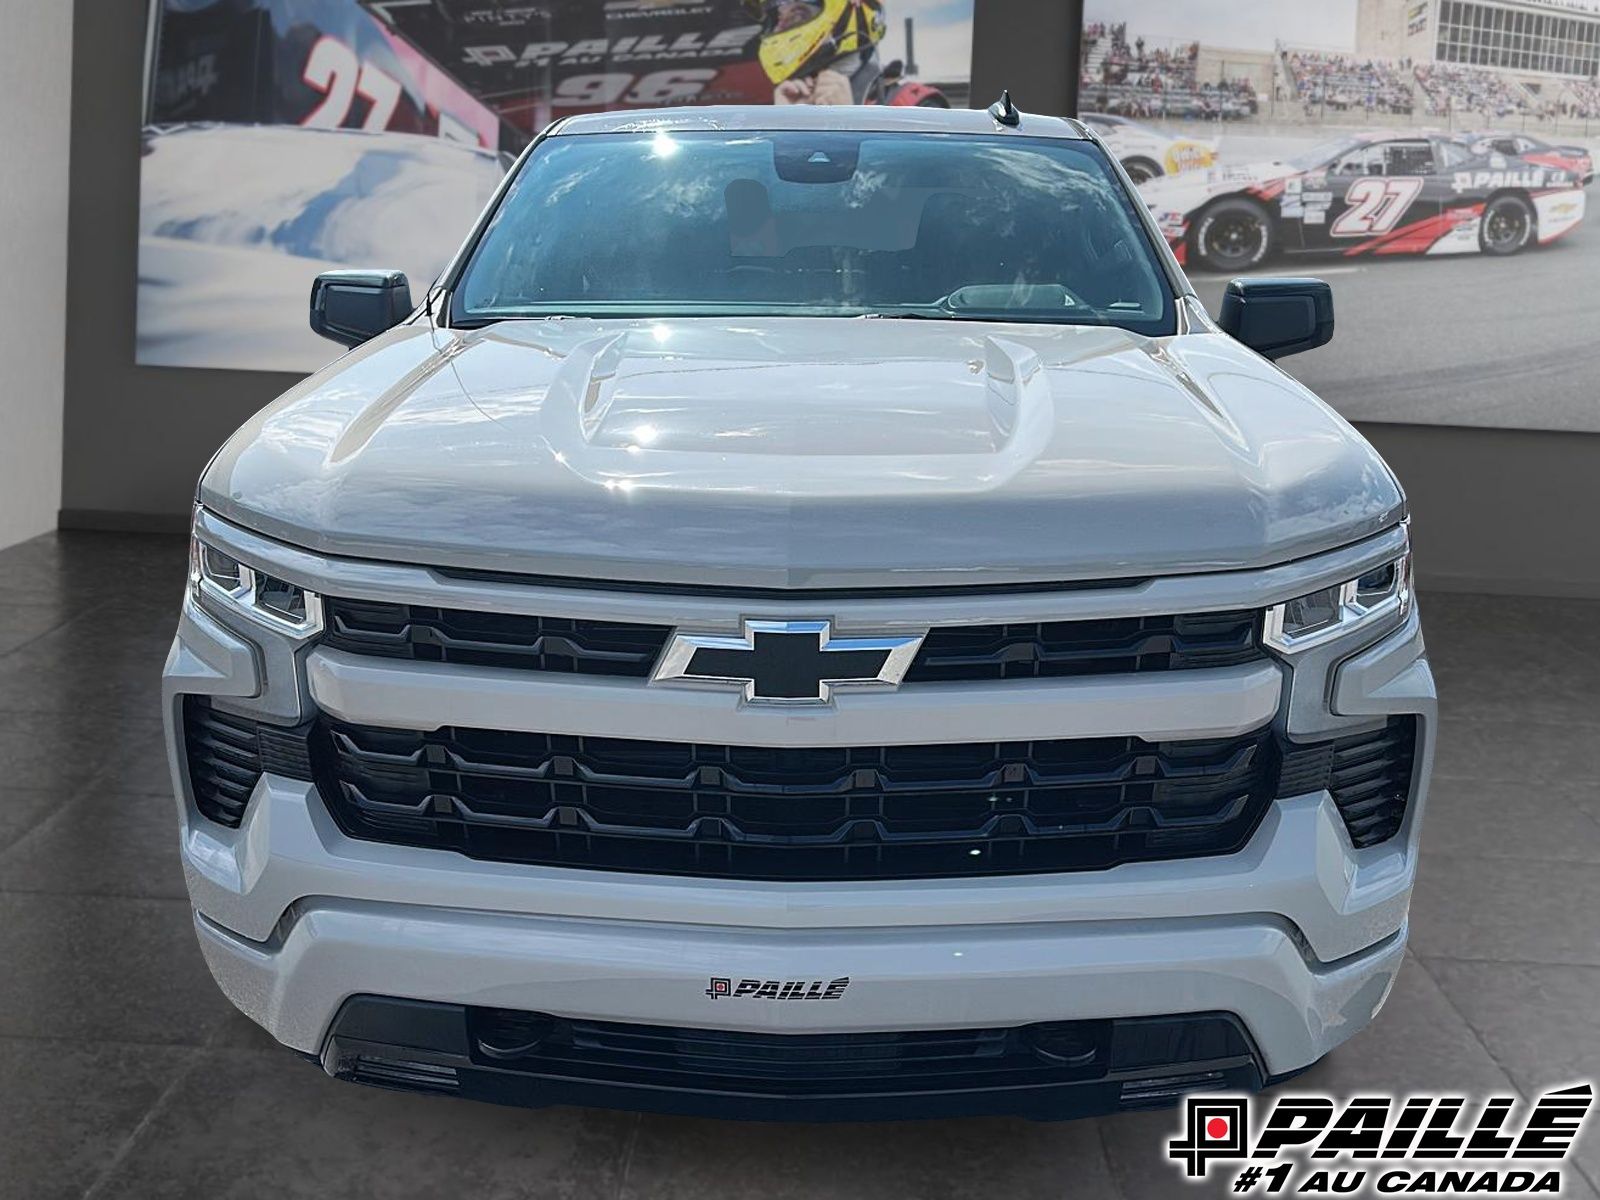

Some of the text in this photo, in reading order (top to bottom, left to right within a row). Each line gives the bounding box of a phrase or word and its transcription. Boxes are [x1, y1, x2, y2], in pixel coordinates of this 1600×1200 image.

[612, 48, 743, 62] CANADA
[302, 35, 401, 133] 27
[553, 69, 718, 106] 96
[1330, 177, 1424, 237] 27
[733, 977, 850, 1000] PAILLÉ
